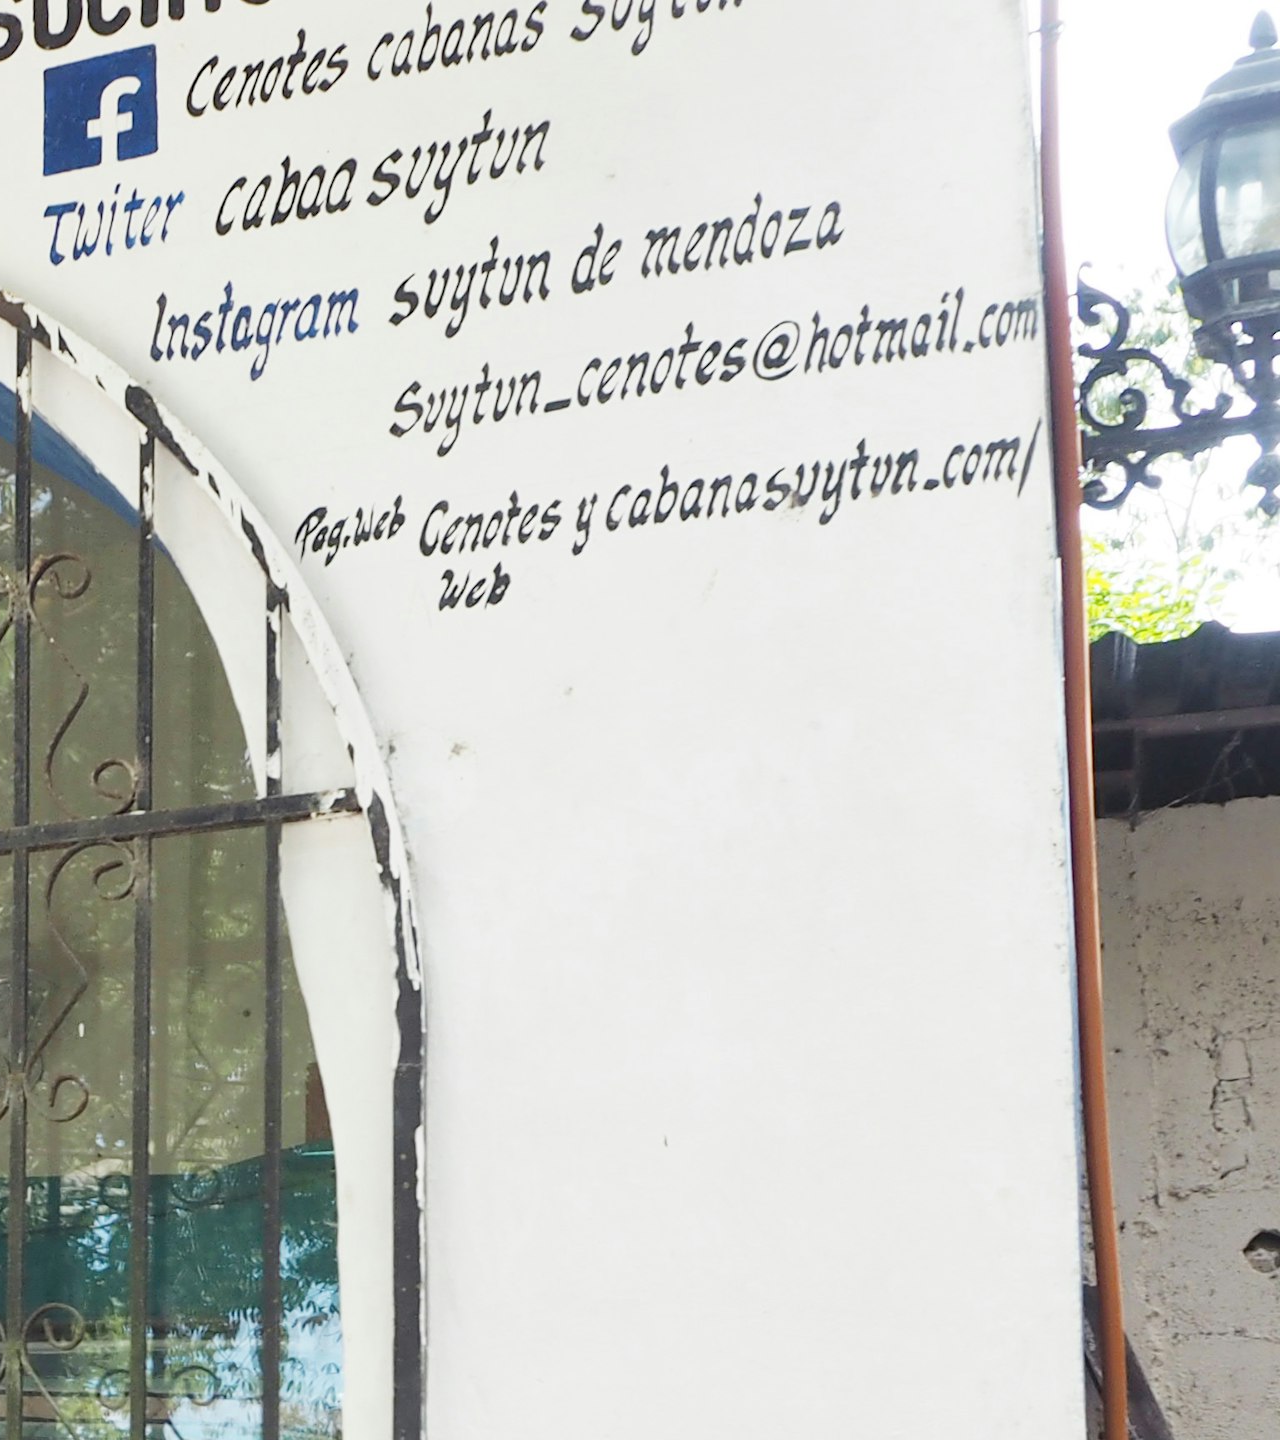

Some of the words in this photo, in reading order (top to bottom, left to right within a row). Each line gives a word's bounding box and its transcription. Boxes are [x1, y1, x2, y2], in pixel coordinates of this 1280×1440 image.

[186, 30, 348, 119] Cenotes
[367, 4, 547, 81] cabanas
[43, 184, 185, 266] Twiter
[215, 155, 358, 236] cabaa
[366, 108, 550, 224] suytun
[150, 281, 360, 381] Instagram
[389, 236, 552, 339] suytun
[571, 224, 623, 294] de
[640, 194, 845, 279] mendoza
[418, 490, 562, 558] Cenotes
[573, 500, 598, 556] y
[440, 561, 511, 611] Web
